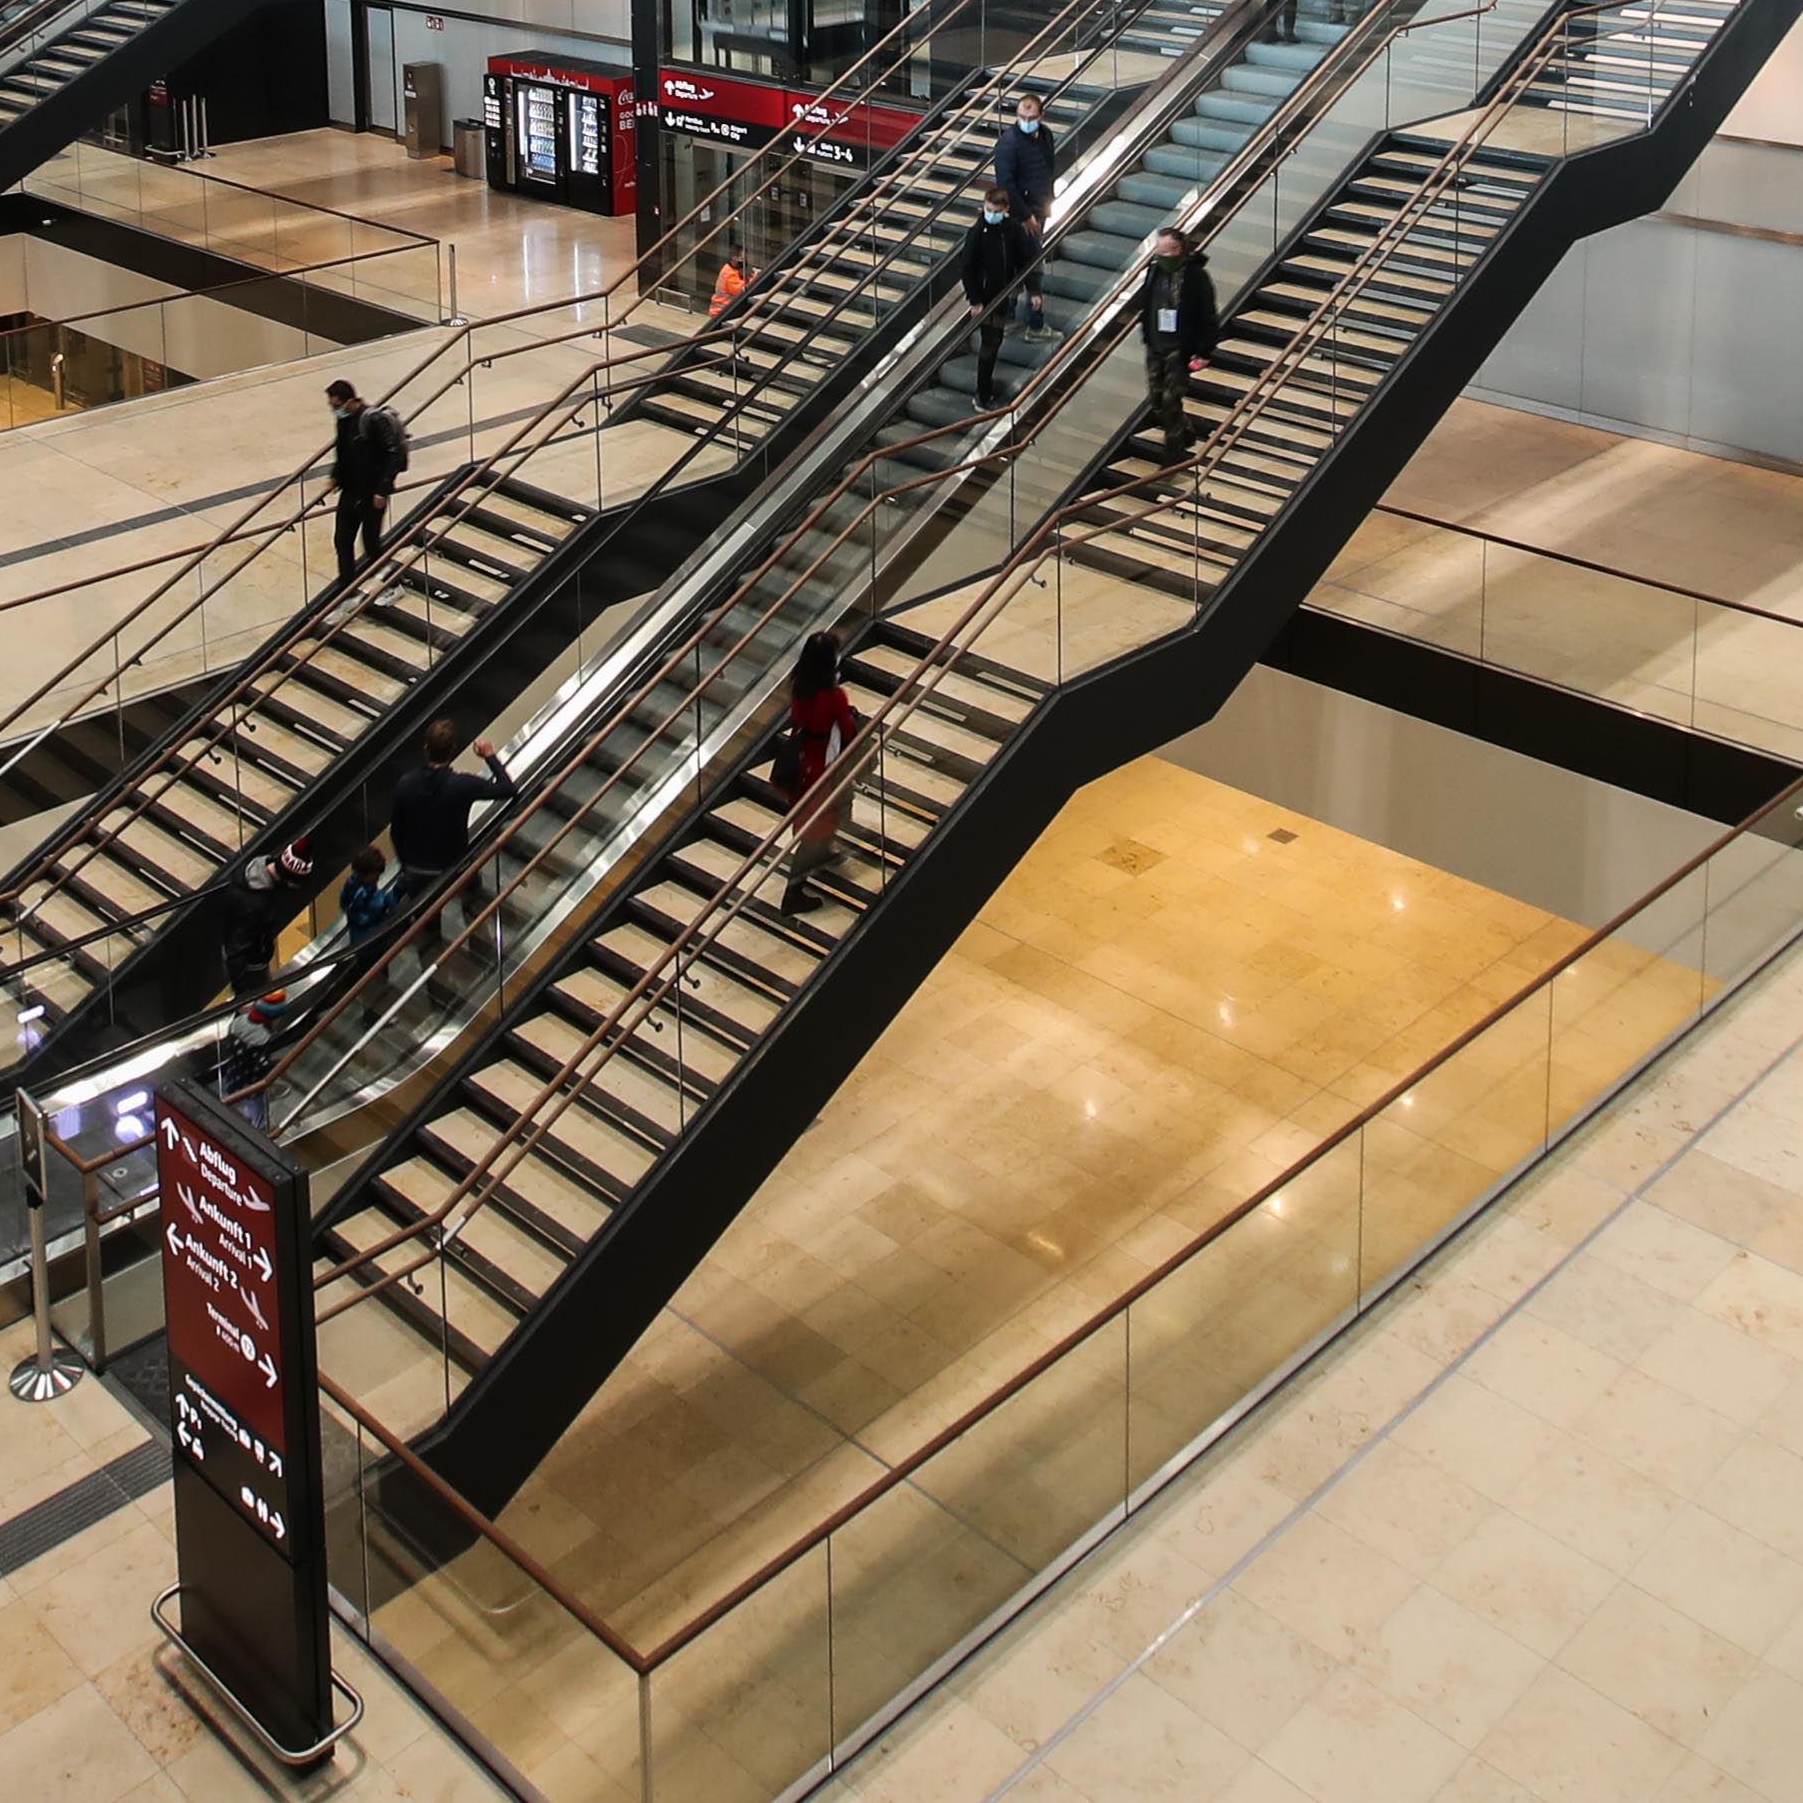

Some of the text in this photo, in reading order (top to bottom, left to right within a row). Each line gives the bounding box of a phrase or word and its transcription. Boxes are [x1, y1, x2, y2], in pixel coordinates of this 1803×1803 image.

[200, 1141, 236, 1186] Abflug
[201, 1162, 243, 1207] Departure
[200, 1195, 251, 1250] Ankunft 1
[186, 1233, 238, 1290] Ankunft 2
[219, 1233, 247, 1266] Arrival
[187, 1255, 219, 1293] Arrival 2
[206, 1301, 240, 1340] Terminal
